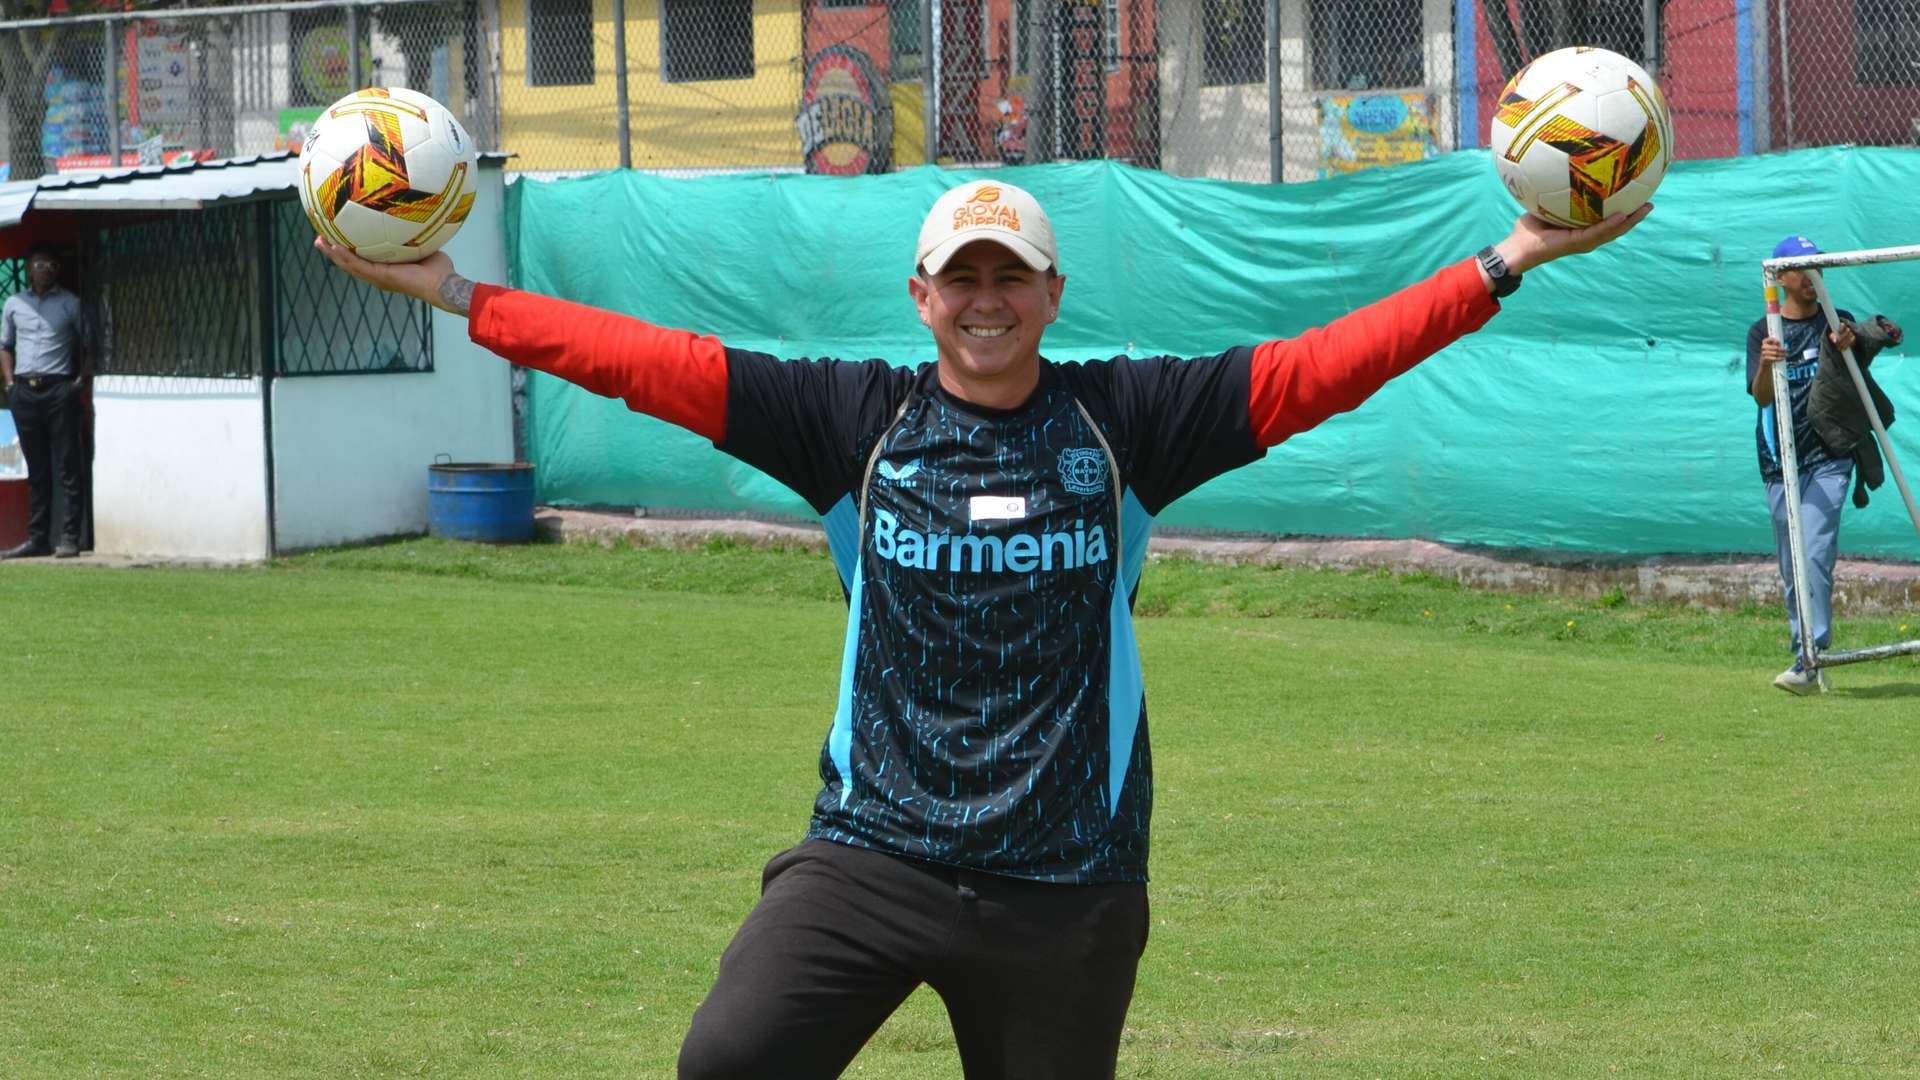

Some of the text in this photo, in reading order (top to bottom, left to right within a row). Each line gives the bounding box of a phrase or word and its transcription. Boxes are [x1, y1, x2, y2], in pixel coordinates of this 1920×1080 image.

[797, 94, 876, 155] DELICIA
[953, 213, 1021, 231] shipping
[874, 506, 1109, 573] Barmenia
